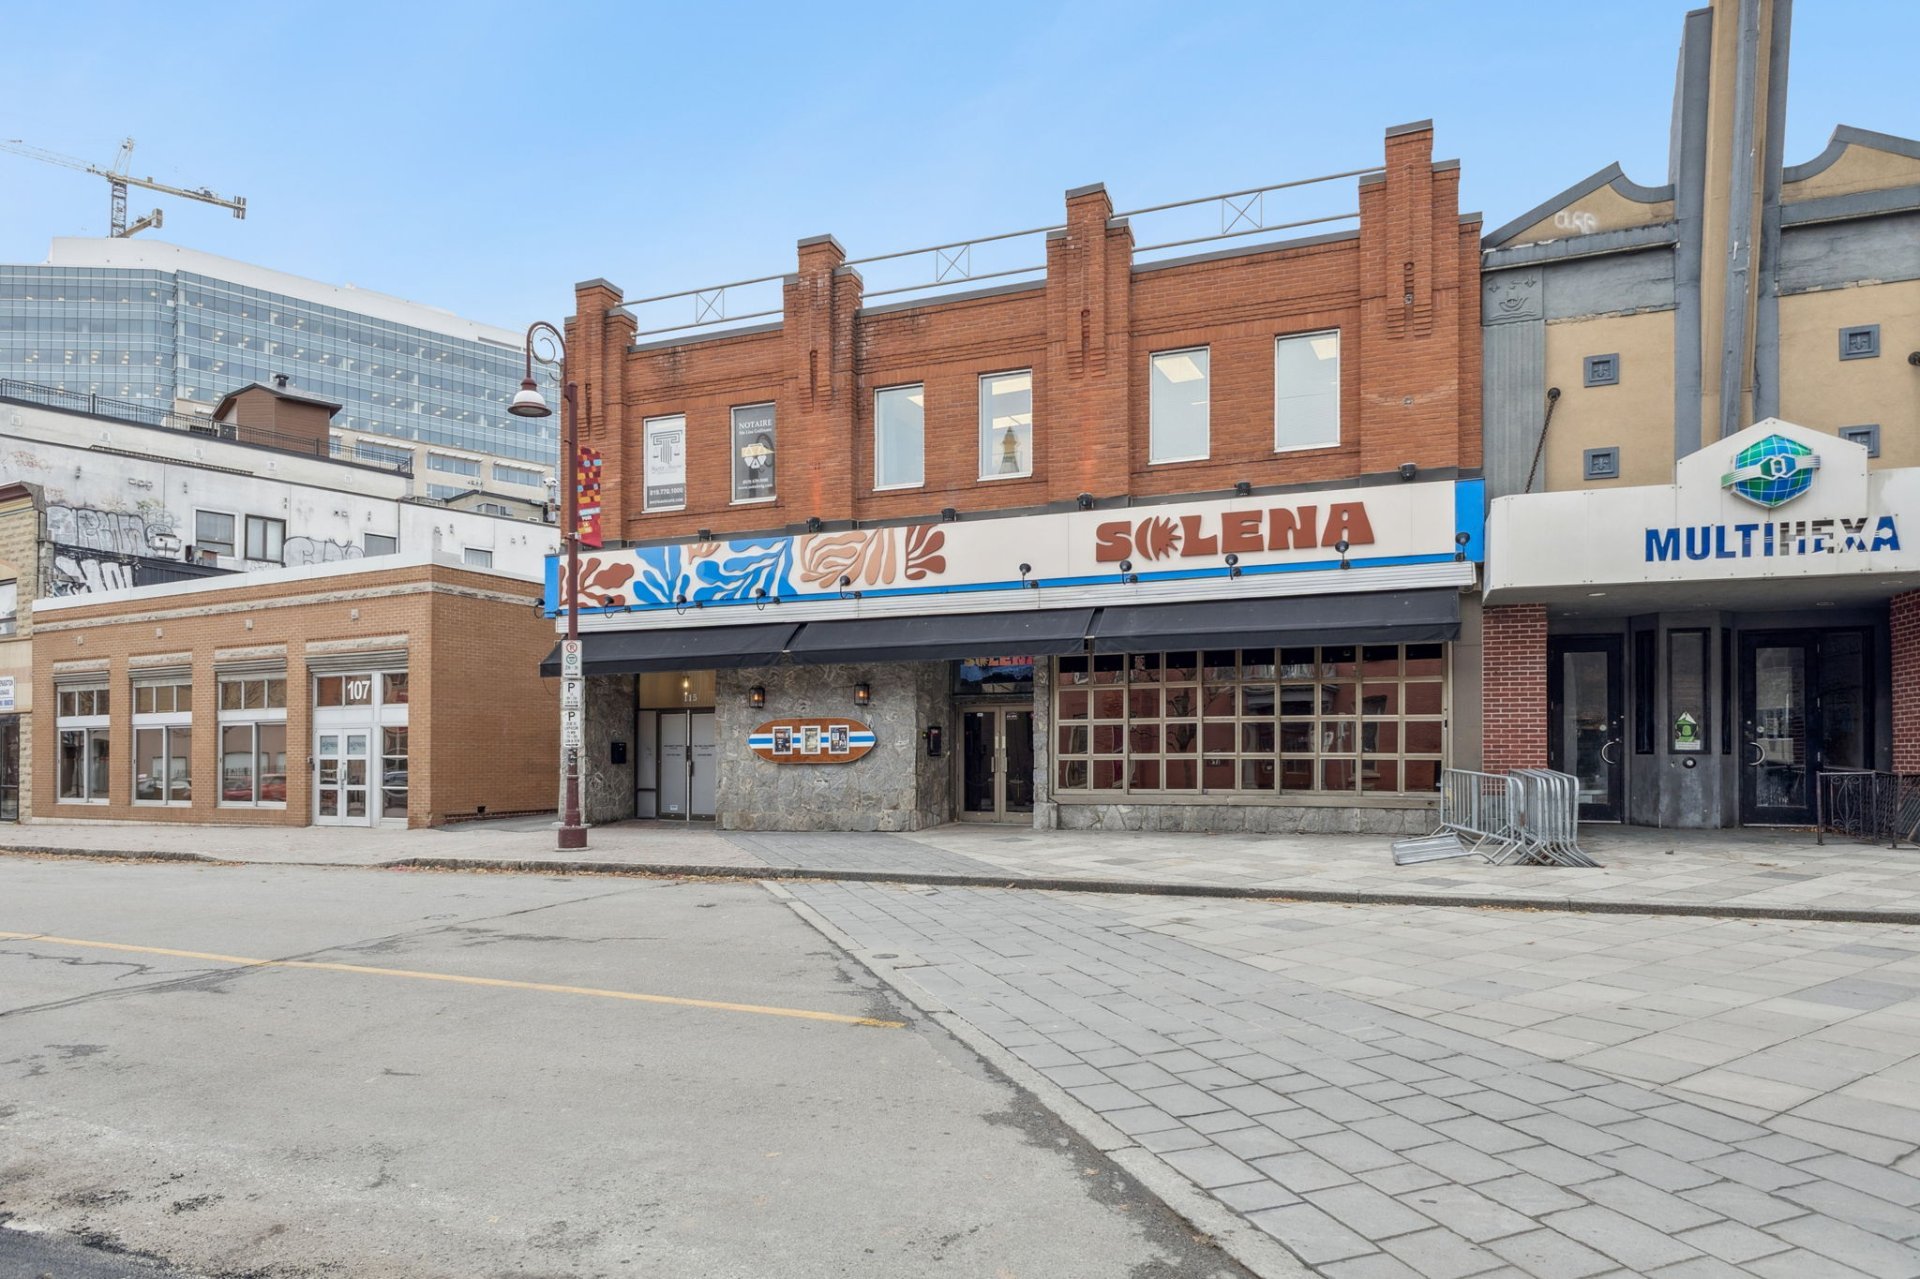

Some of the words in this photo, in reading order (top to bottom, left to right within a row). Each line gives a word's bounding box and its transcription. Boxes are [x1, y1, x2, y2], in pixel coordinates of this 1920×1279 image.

[738, 419, 772, 430] NOTAIRE
[1096, 501, 1375, 562] SOLENA
[1645, 515, 1901, 562] MULTIHEXA
[347, 680, 370, 700] 107
[567, 682, 576, 693] P
[568, 711, 576, 721] P
